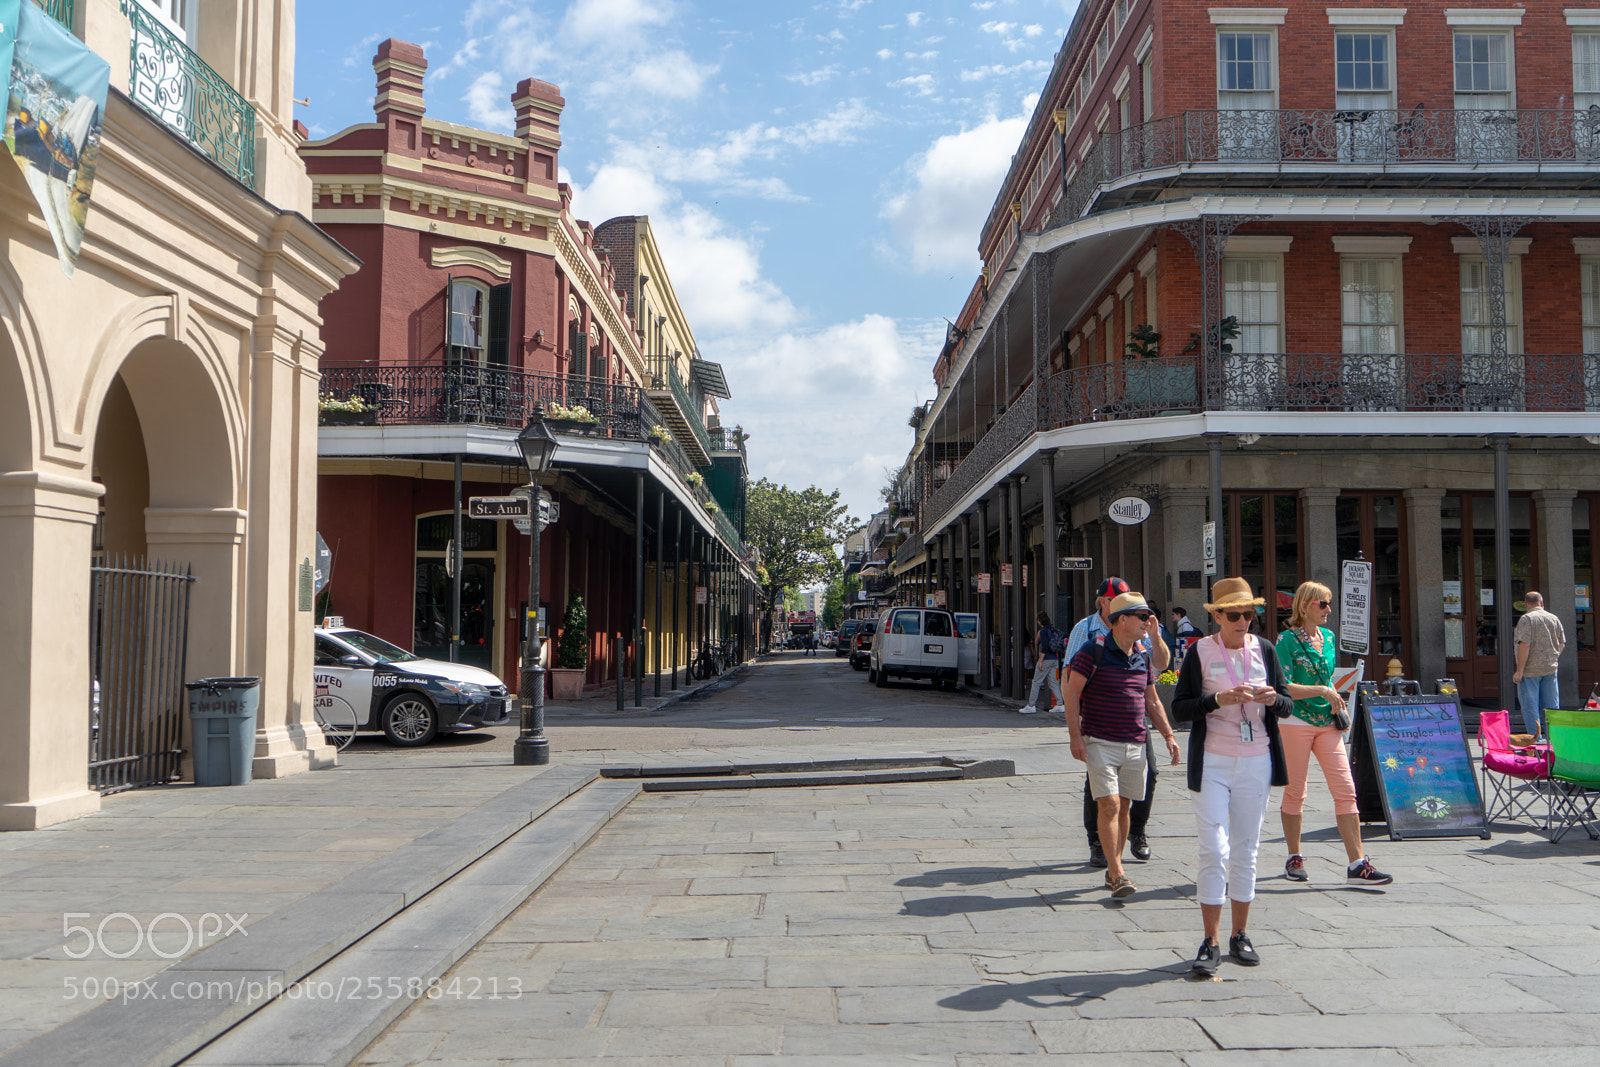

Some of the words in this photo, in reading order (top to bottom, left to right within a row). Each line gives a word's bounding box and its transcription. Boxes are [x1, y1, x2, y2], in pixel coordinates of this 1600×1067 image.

[476, 503, 492, 514] St.
[496, 503, 521, 514] Ann
[1112, 499, 1143, 520] Stanley
[1348, 565, 1366, 573] JACKSON
[1346, 593, 1367, 601] VEHICLES
[1346, 600, 1366, 608] ALLOWED
[314, 675, 342, 689] NITED
[373, 675, 398, 687] 0055
[1387, 722, 1434, 739] Singles
